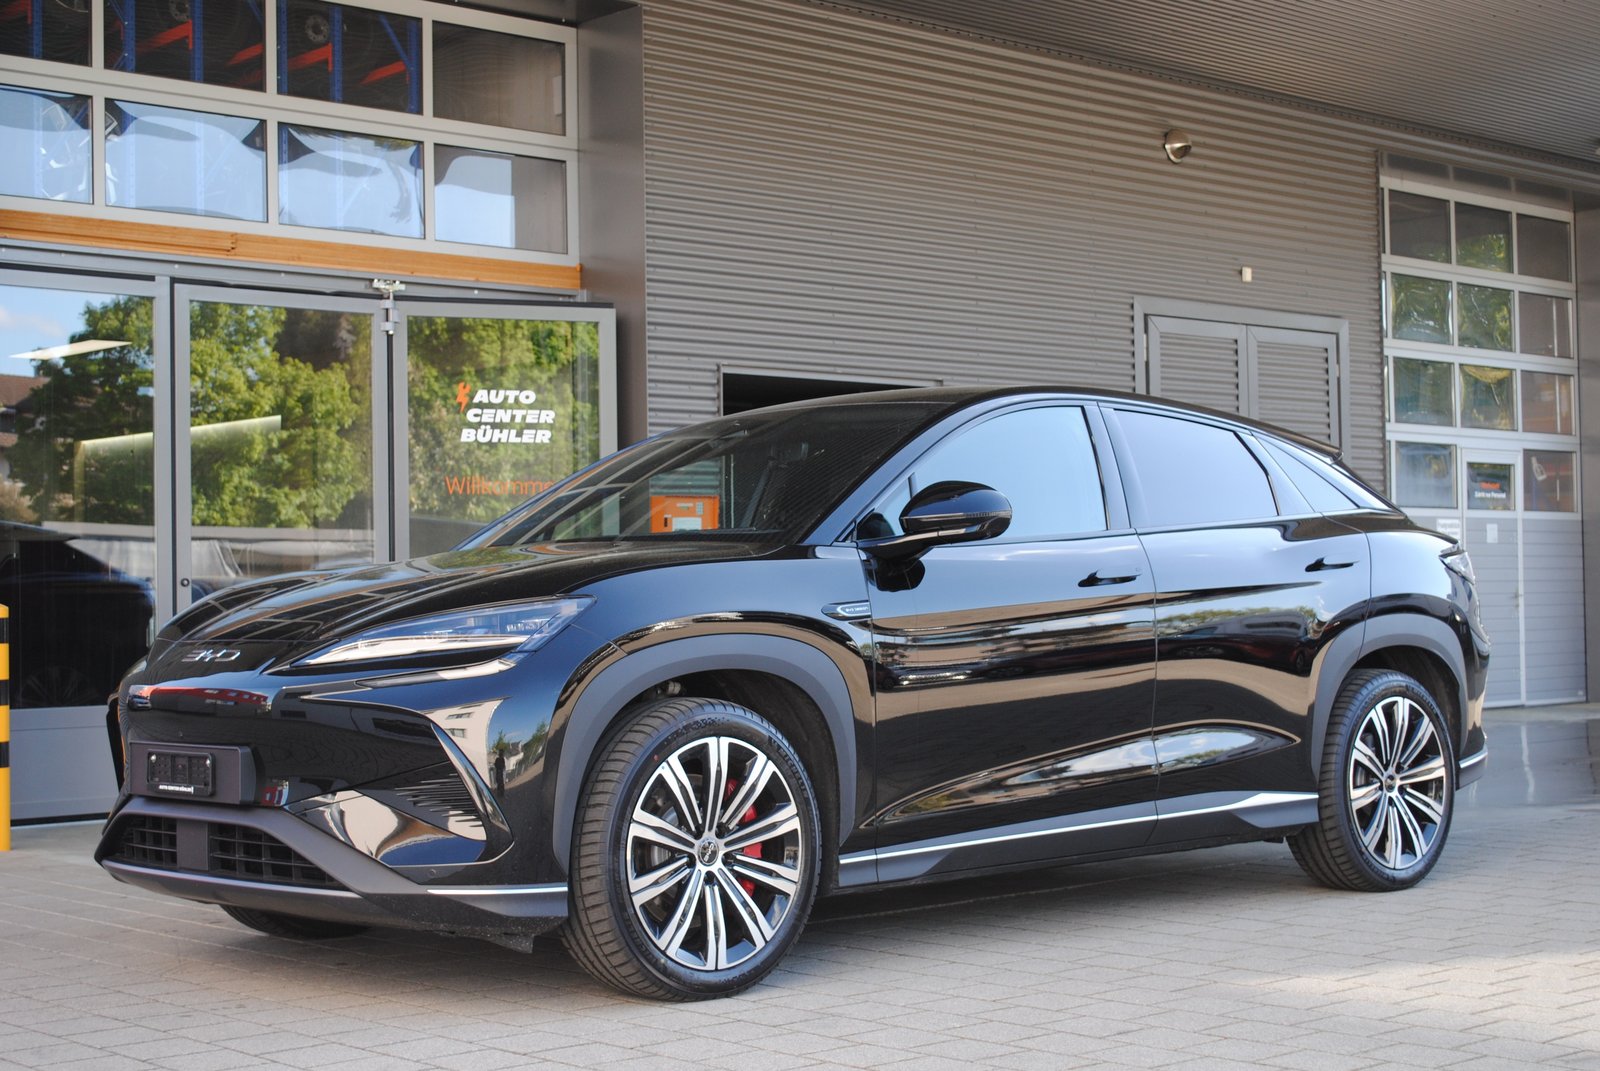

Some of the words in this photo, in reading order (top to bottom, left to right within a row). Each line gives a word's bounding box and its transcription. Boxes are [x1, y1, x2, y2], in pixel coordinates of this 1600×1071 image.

[472, 389, 536, 404] AUTO
[466, 408, 556, 424] CENTER
[460, 424, 552, 443] BÜHLER
[181, 649, 241, 662] BYD
